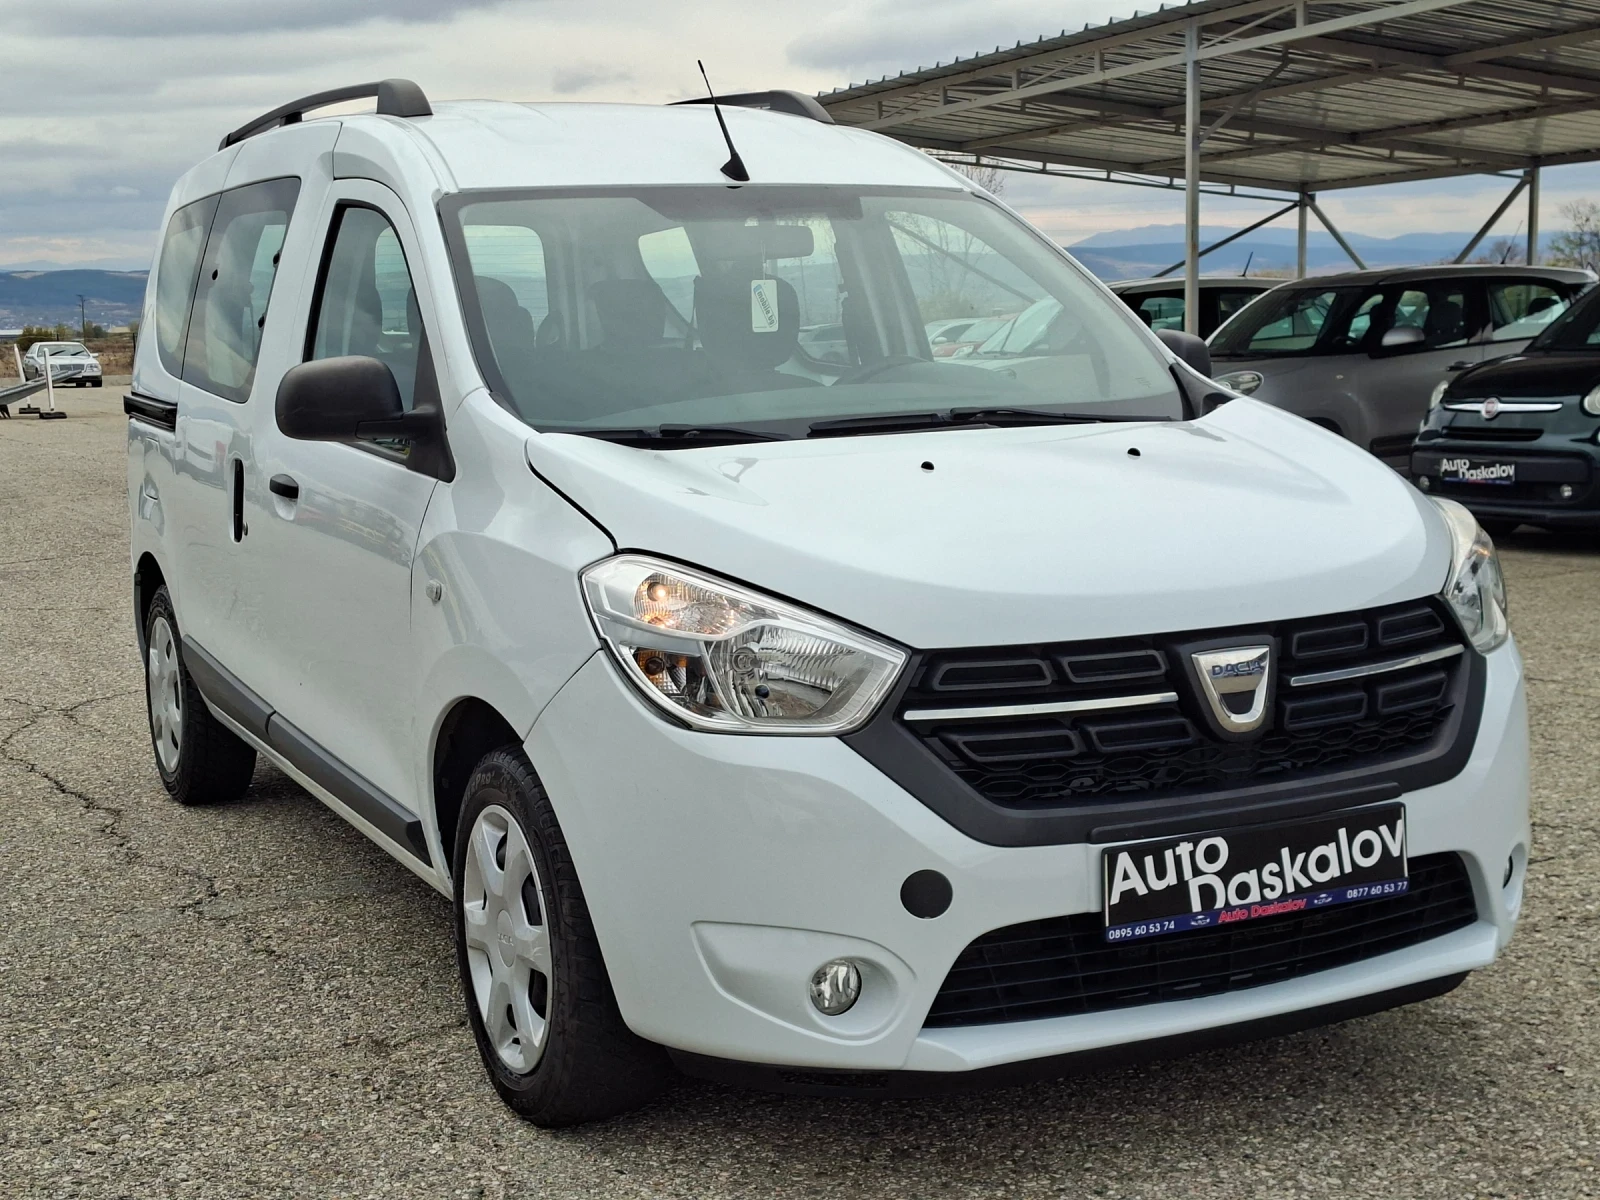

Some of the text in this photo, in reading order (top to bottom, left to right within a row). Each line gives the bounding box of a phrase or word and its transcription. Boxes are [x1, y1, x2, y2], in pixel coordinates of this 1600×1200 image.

[757, 291, 776, 326] mobile.bg
[1441, 458, 1470, 472] Auto
[1212, 660, 1263, 676] DACIA
[1110, 836, 1229, 906] Auto
[1188, 819, 1403, 913] Daskalov
[1108, 881, 1408, 940] 0895 60 53 74 Auto Daskalov 0877 60 53 77
